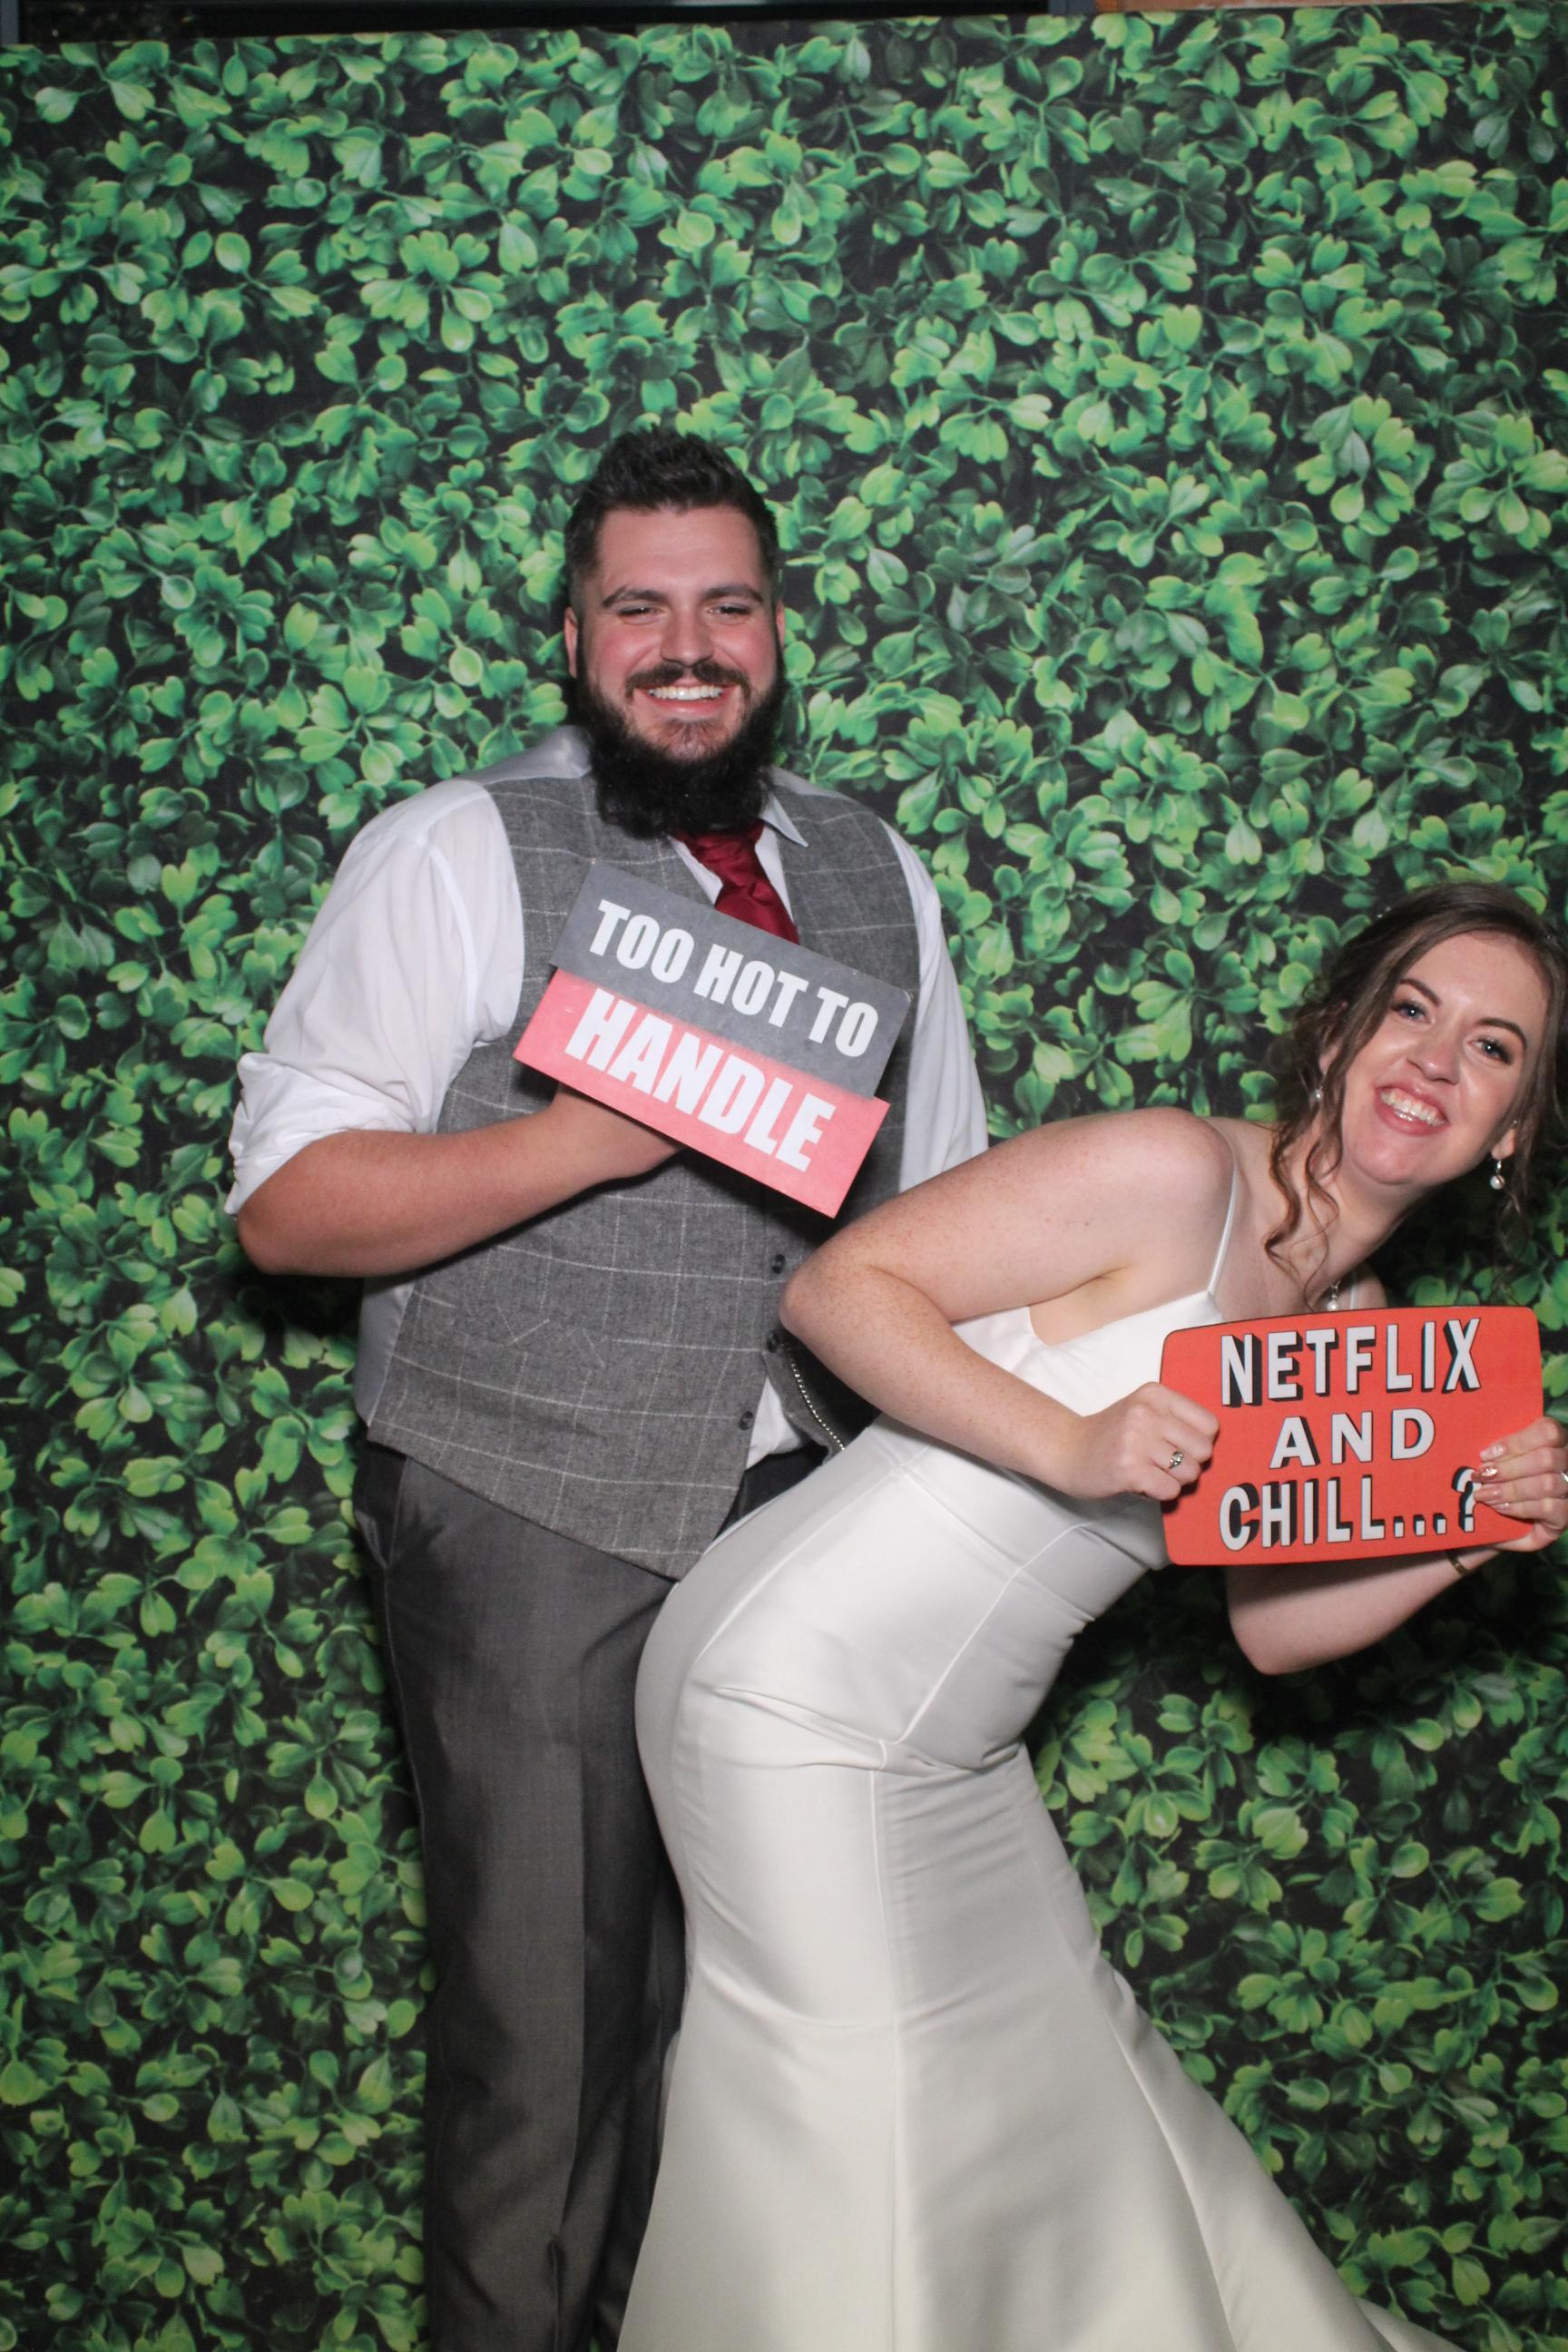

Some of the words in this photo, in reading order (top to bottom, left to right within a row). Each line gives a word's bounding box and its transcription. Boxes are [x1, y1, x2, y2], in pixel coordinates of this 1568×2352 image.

[590, 899, 694, 983] TOO
[693, 943, 809, 1027] HOT
[808, 986, 878, 1057] TO
[564, 988, 837, 1172] HANDLE
[1221, 1318, 1481, 1406] NETFLIX
[1269, 1408, 1436, 1469] AND
[1220, 1466, 1482, 1551] CHILL...?
